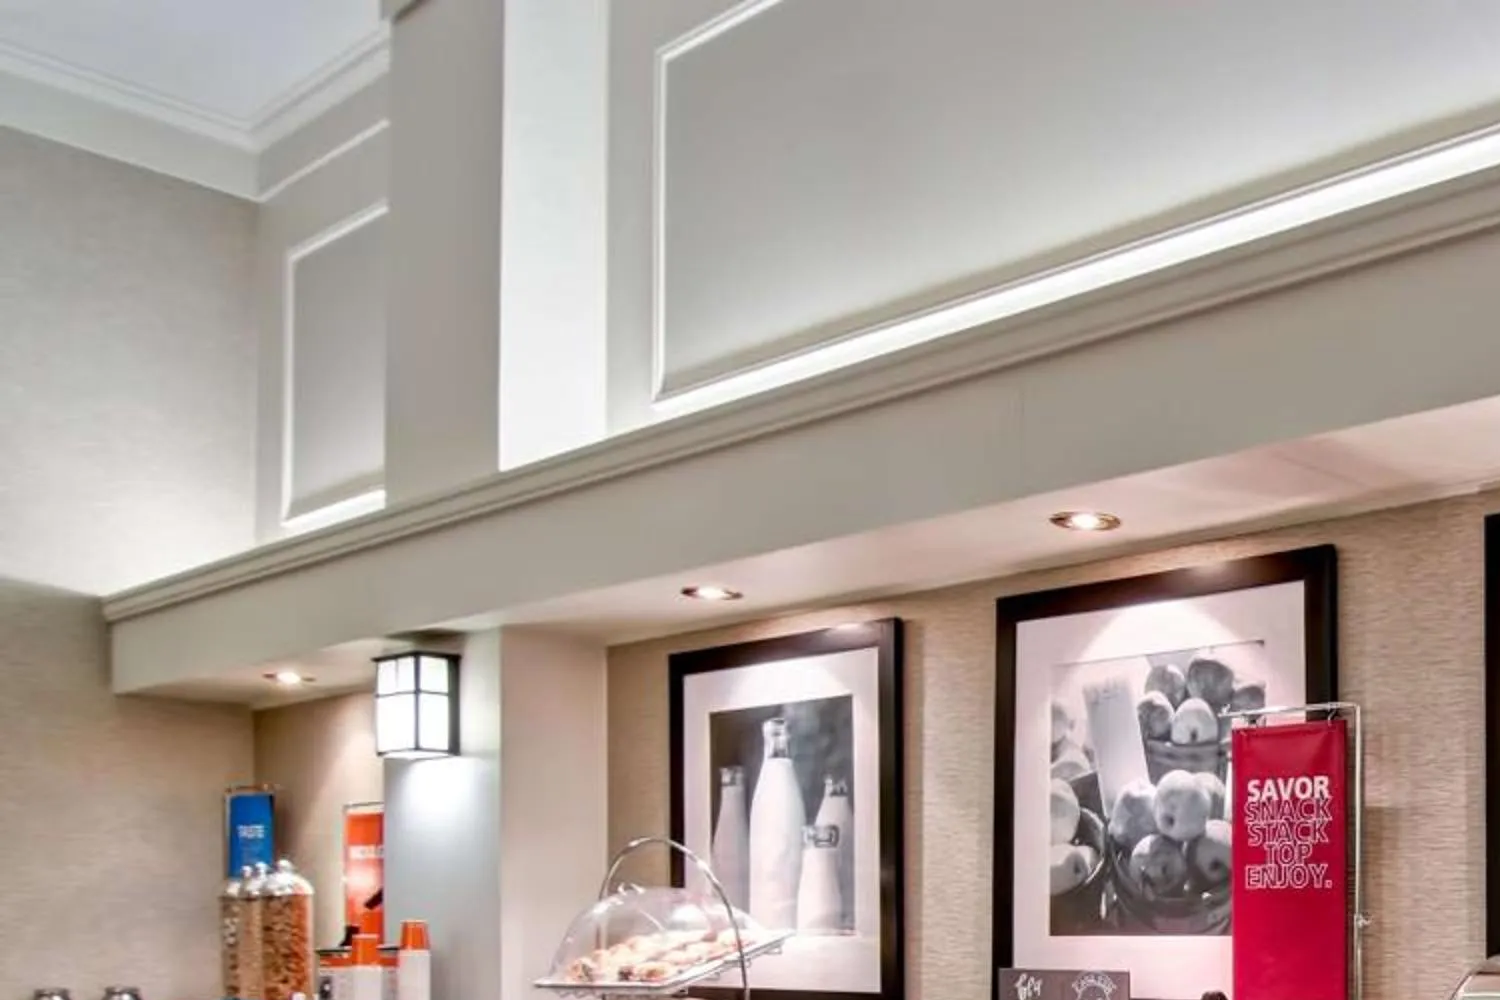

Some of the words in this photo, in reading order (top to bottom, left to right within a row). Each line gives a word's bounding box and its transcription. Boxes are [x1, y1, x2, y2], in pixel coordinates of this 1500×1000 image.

[1247, 776, 1330, 802] SAVOR
[1244, 797, 1333, 824] SNACK
[1247, 819, 1329, 846] STACK
[1264, 841, 1313, 865] TOP
[1245, 863, 1334, 889] ENJOY.
